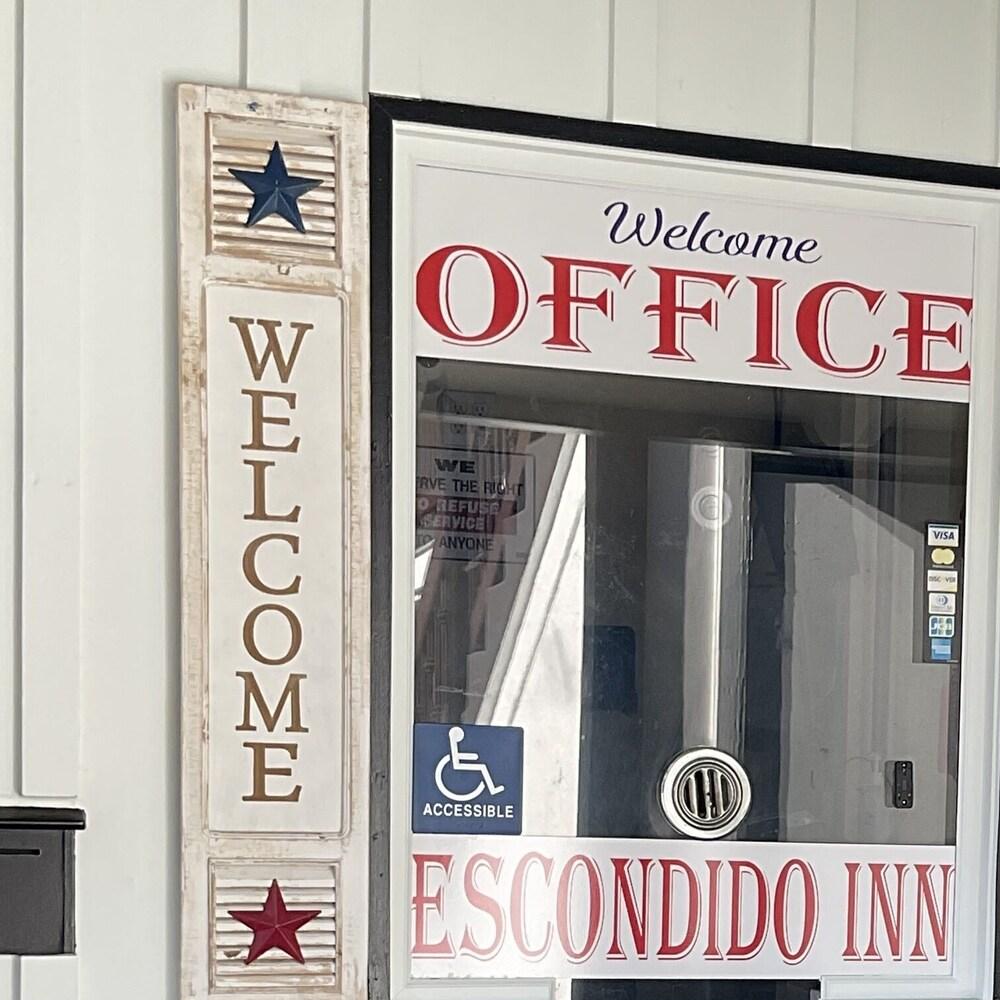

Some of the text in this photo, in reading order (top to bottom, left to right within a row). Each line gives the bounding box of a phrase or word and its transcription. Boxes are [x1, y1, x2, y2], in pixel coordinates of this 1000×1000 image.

[603, 202, 822, 264] Welcome
[416, 245, 974, 386] OFFICE
[434, 458, 475, 474] WE
[416, 476, 446, 491] RVE
[452, 479, 479, 494] THE
[436, 498, 500, 515] REFUSE
[423, 514, 485, 531] SERVICE
[439, 535, 494, 551] ANYONE
[933, 530, 955, 540] VISA
[228, 315, 314, 803] WELCOME
[422, 802, 515, 819] ACCESSIBLE
[410, 852, 955, 965] ESCONDIDO INN
